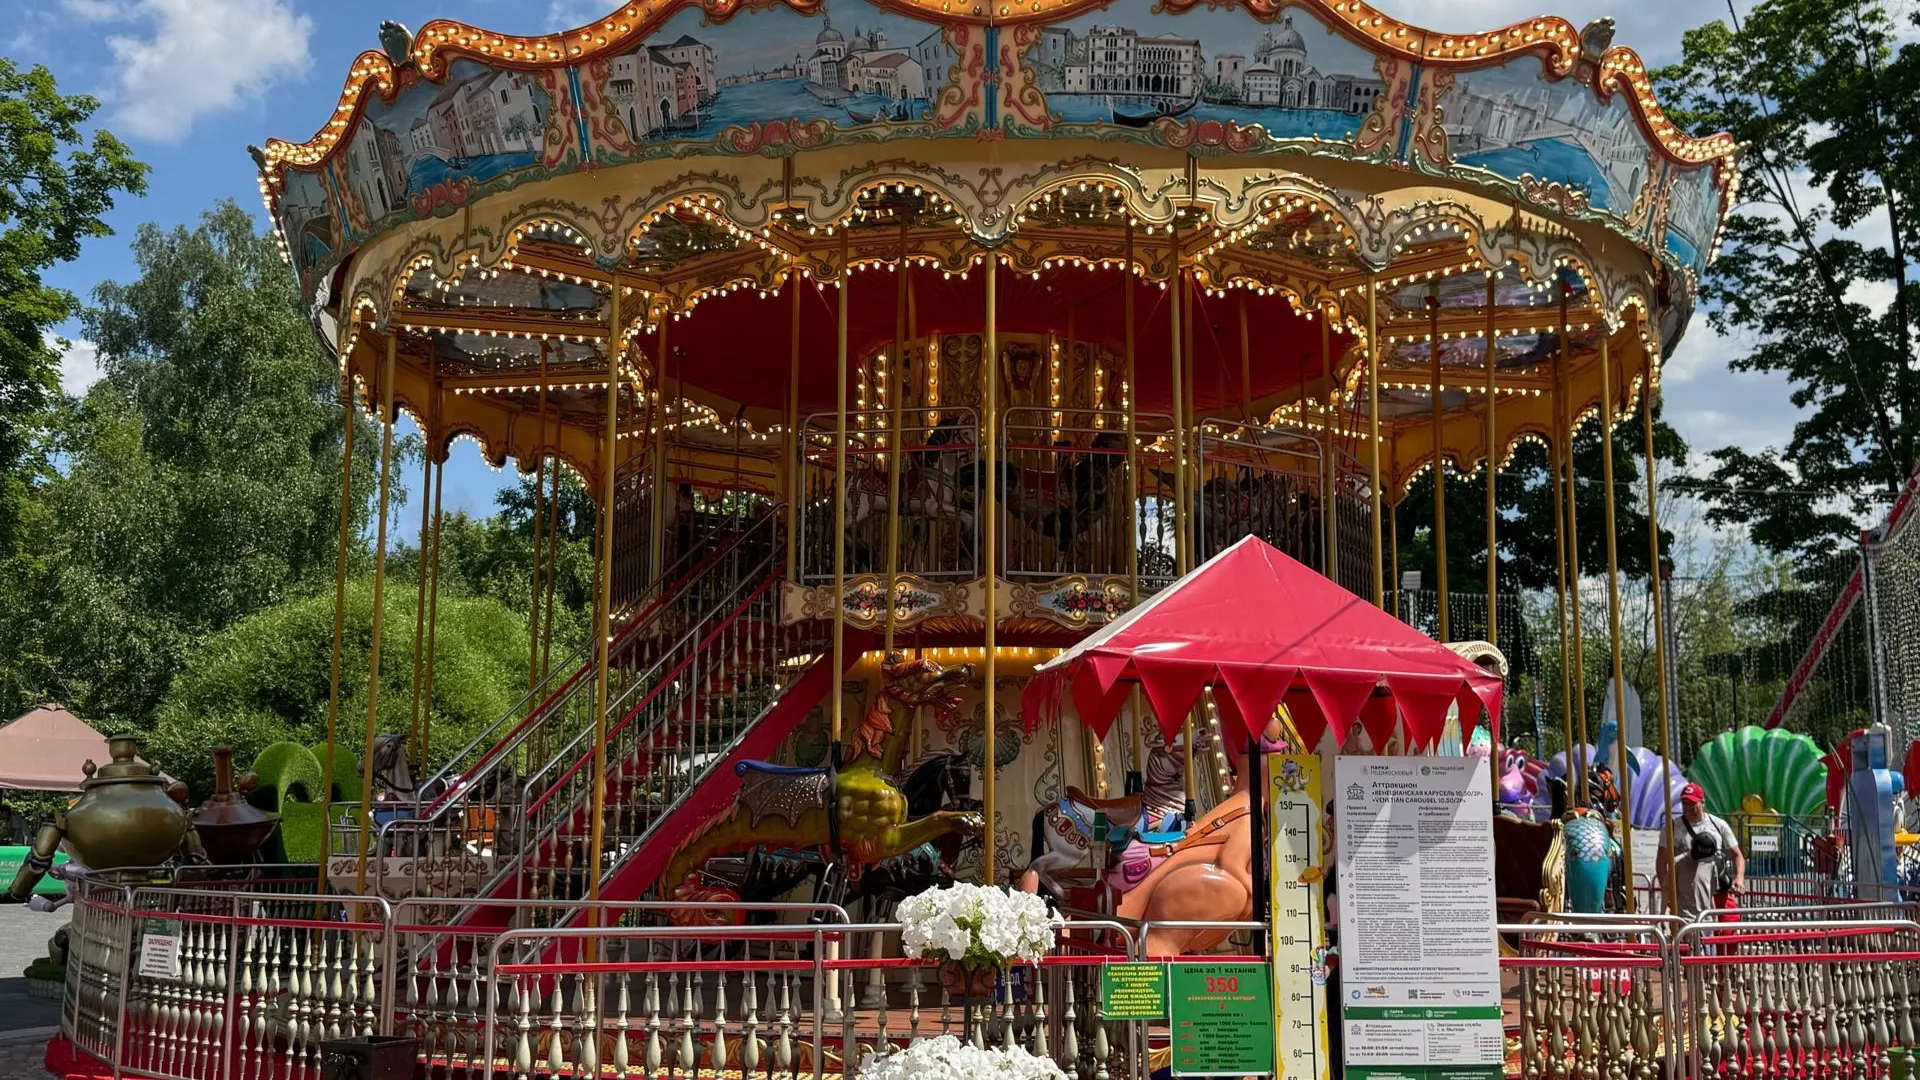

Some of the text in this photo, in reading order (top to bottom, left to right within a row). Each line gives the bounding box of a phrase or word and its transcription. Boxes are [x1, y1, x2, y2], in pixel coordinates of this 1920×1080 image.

[1372, 781, 1417, 789] Аттракцион
[1280, 801, 1293, 810] 150
[1285, 828, 1297, 836] 140
[1285, 855, 1297, 863] 130
[1285, 881, 1297, 890] 120
[1286, 909, 1297, 917] 110
[1280, 936, 1294, 945] 100
[1291, 964, 1300, 973] 90
[1205, 976, 1238, 993] 350
[1291, 993, 1301, 1001] 80
[1292, 1020, 1302, 1028] 70
[1293, 1049, 1302, 1058] 60
